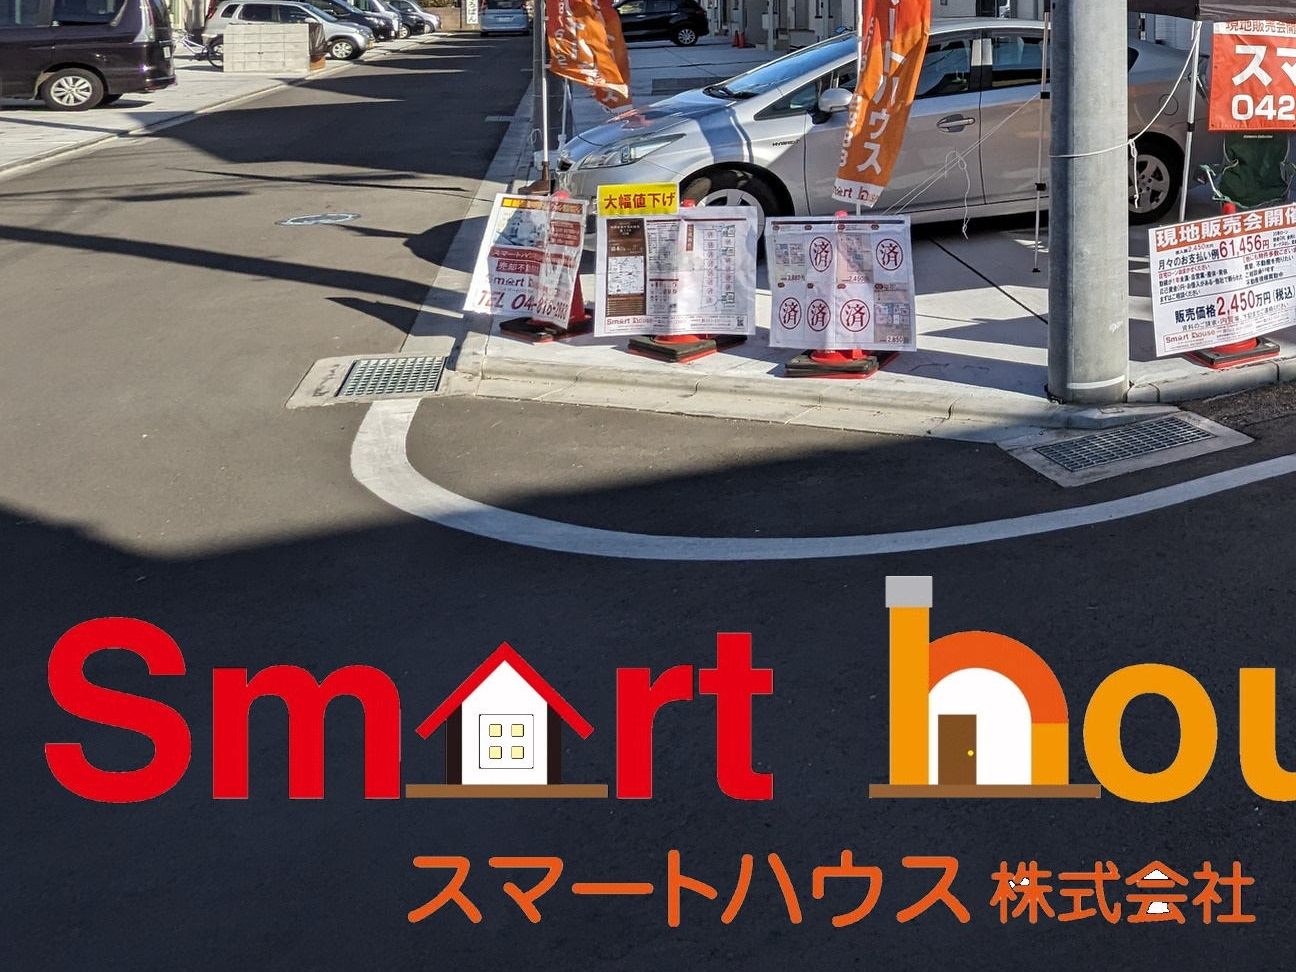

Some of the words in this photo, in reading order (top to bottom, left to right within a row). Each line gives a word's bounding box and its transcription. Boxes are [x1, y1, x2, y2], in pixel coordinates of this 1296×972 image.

[604, 192, 676, 210] 大幅値下げ
[814, 241, 830, 267] 済
[880, 242, 899, 267] 済
[478, 290, 505, 309] TEL
[783, 301, 798, 325] 済
[811, 303, 826, 327] 済
[845, 303, 865, 327] 済
